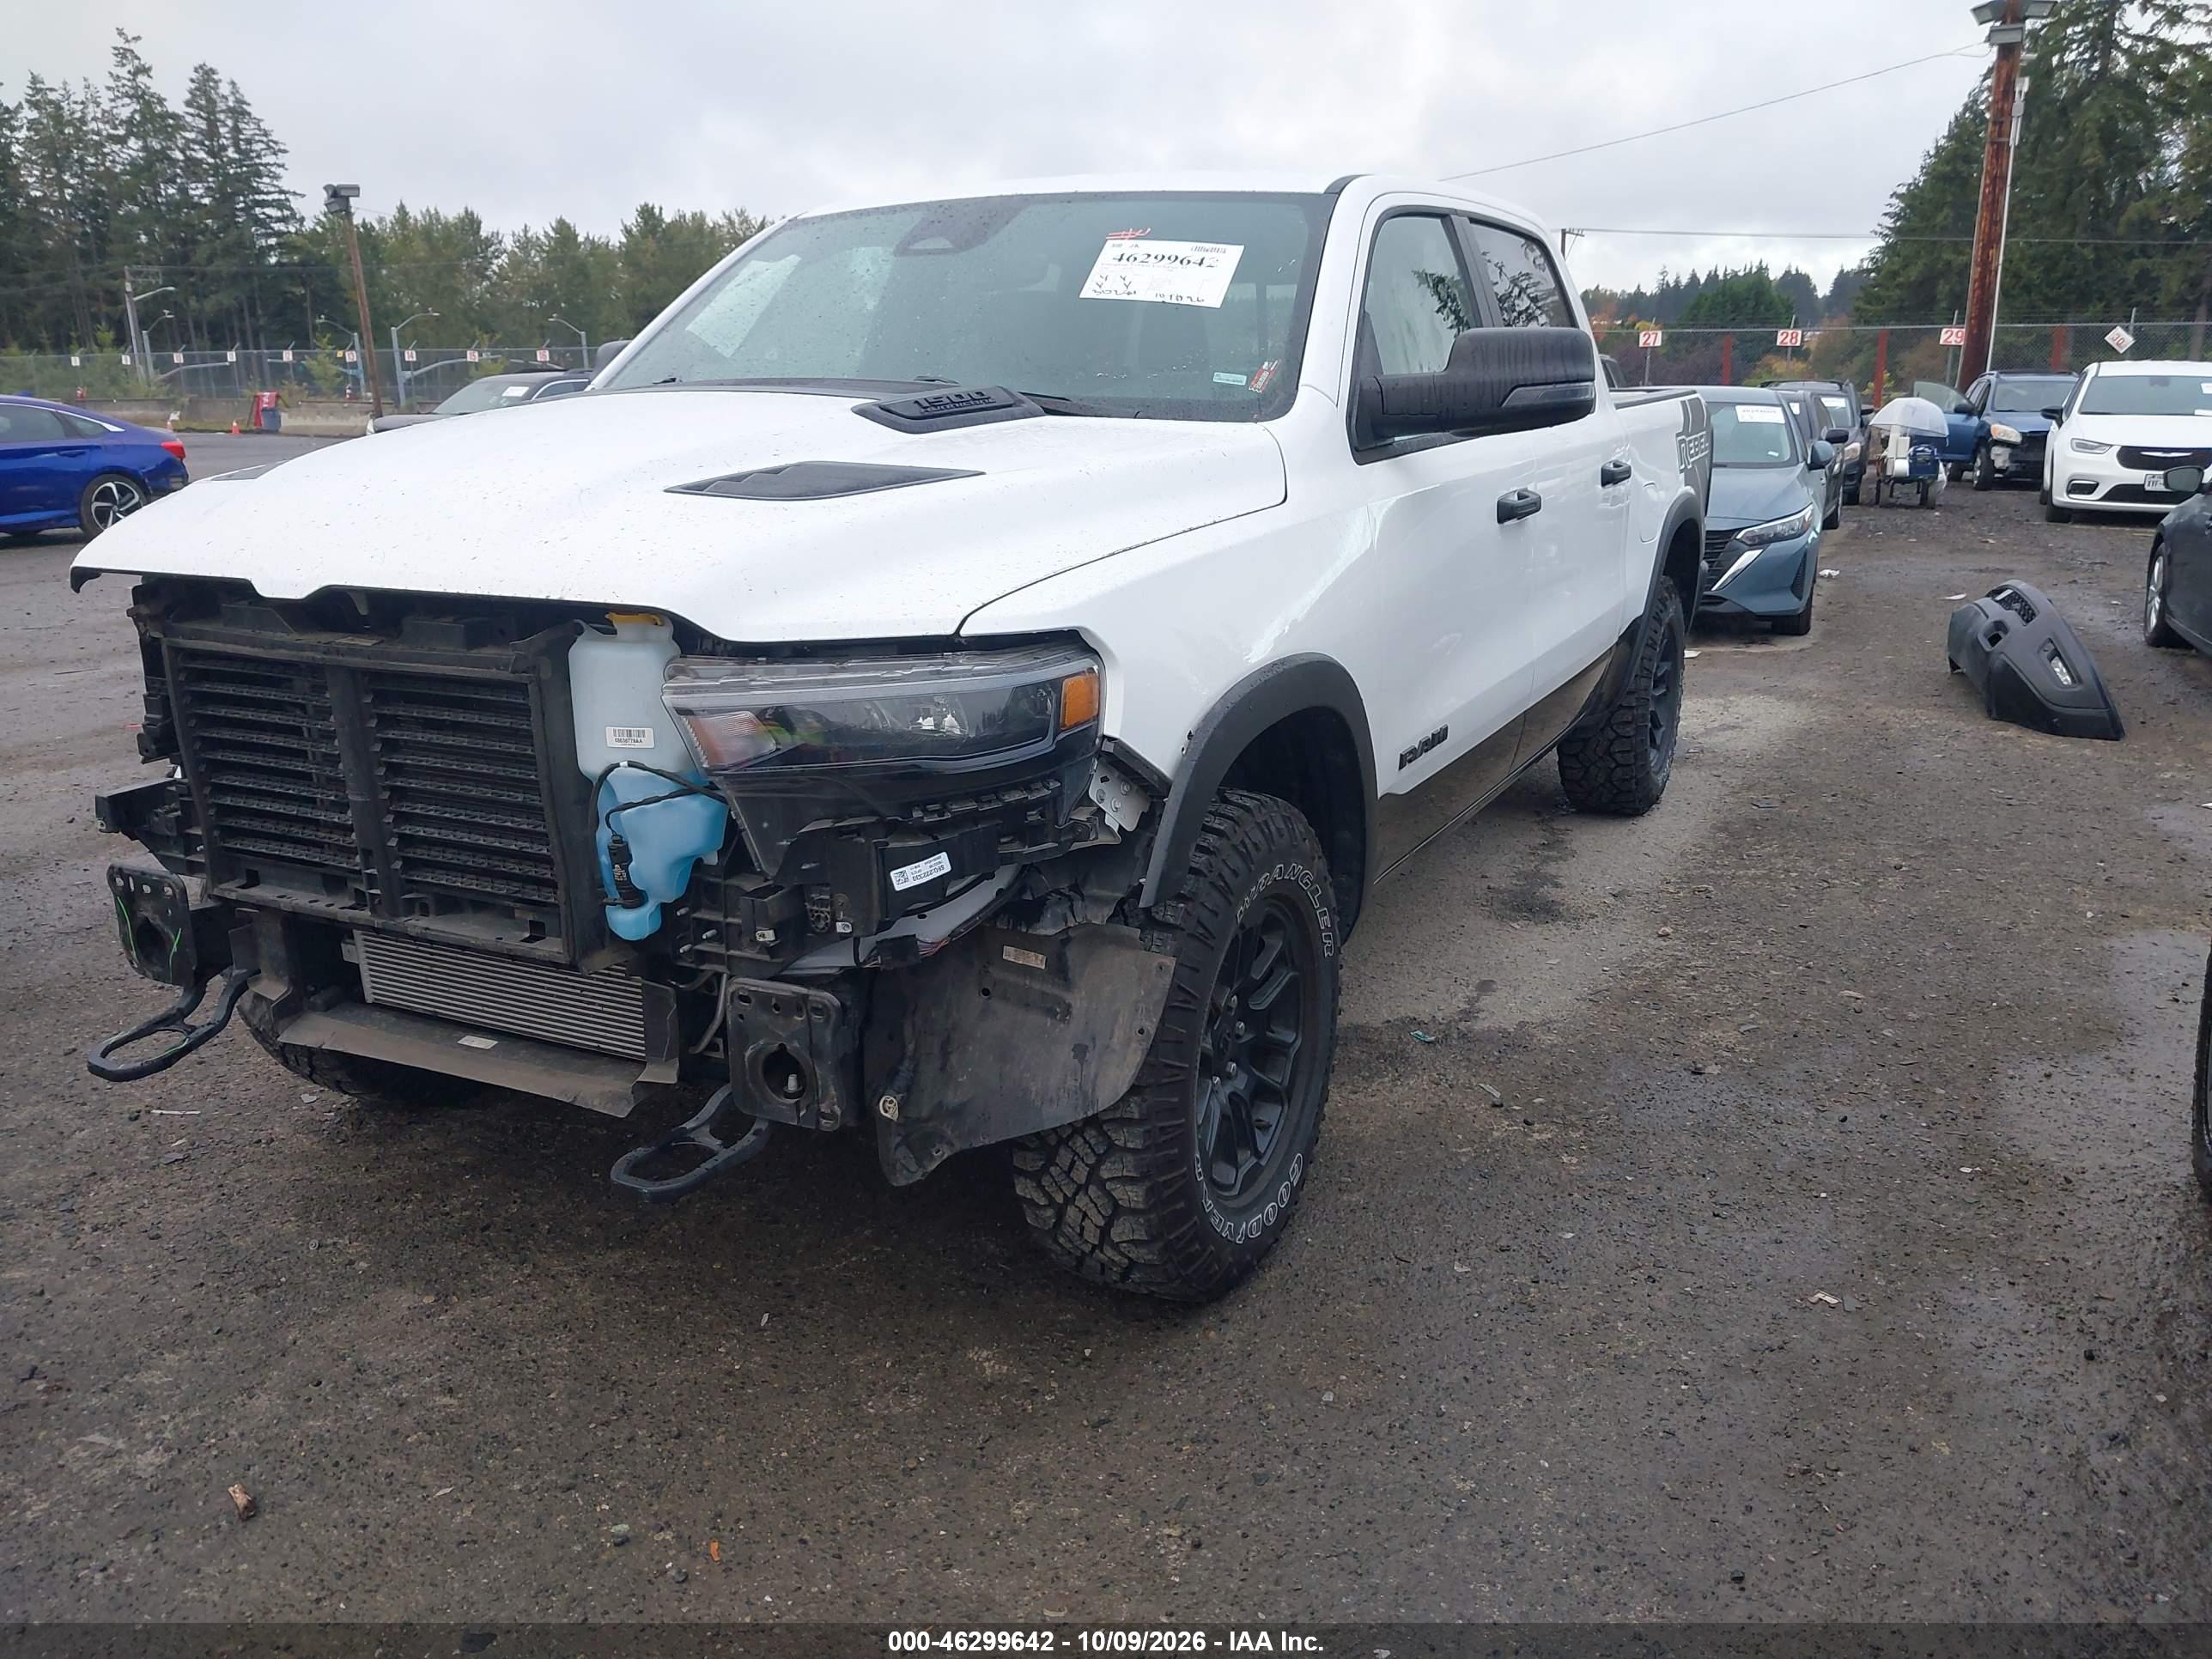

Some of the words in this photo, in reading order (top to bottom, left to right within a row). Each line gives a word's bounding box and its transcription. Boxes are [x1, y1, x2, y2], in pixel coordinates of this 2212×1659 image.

[1111, 252, 1220, 269] 46299642
[1642, 331, 1658, 347] 27
[1779, 331, 1799, 345] 28
[1942, 329, 1965, 343] 29
[914, 391, 992, 410] 1500
[1398, 724, 1449, 770] RAM
[1237, 862, 1334, 957] WRANGLER
[1194, 1152, 1304, 1244] GOODYEAR
